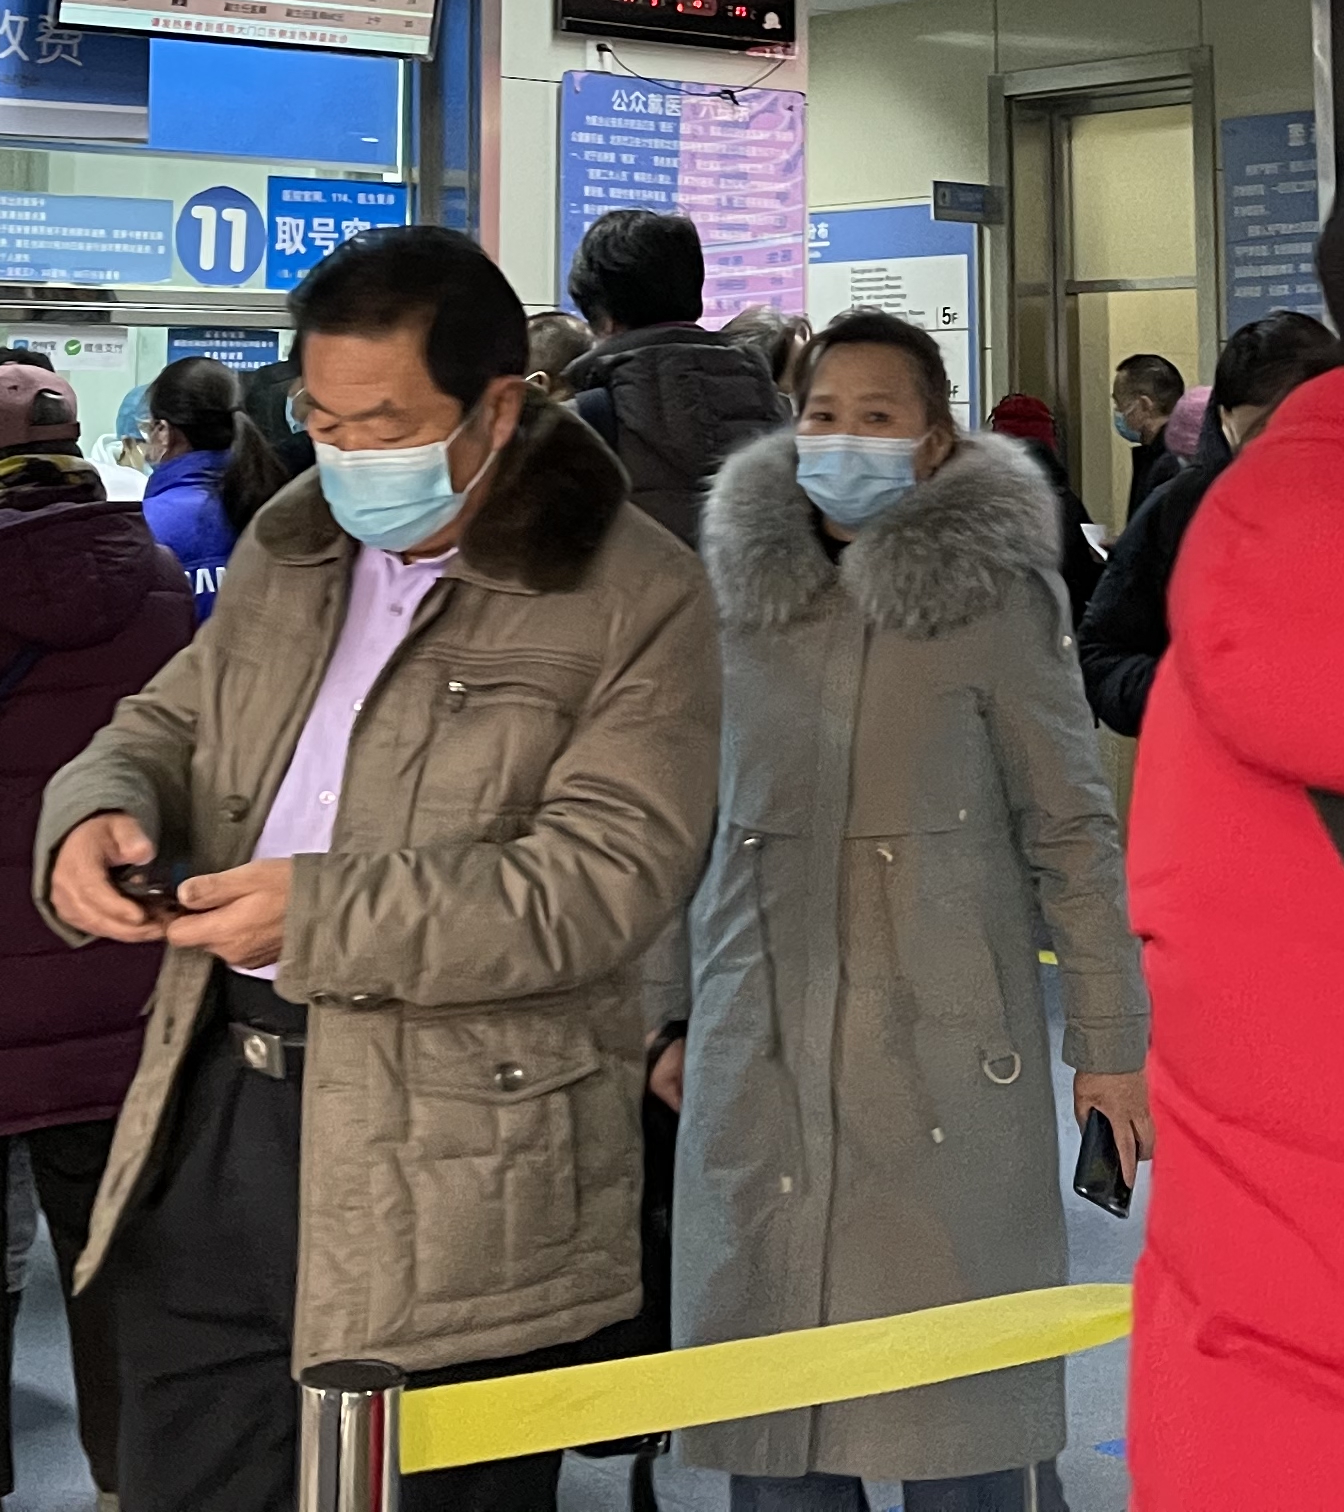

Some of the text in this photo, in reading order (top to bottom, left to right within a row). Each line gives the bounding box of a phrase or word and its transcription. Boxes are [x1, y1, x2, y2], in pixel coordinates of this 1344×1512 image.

[191, 205, 247, 273] 11
[275, 216, 400, 256] 取号
[941, 306, 960, 326] 5F
